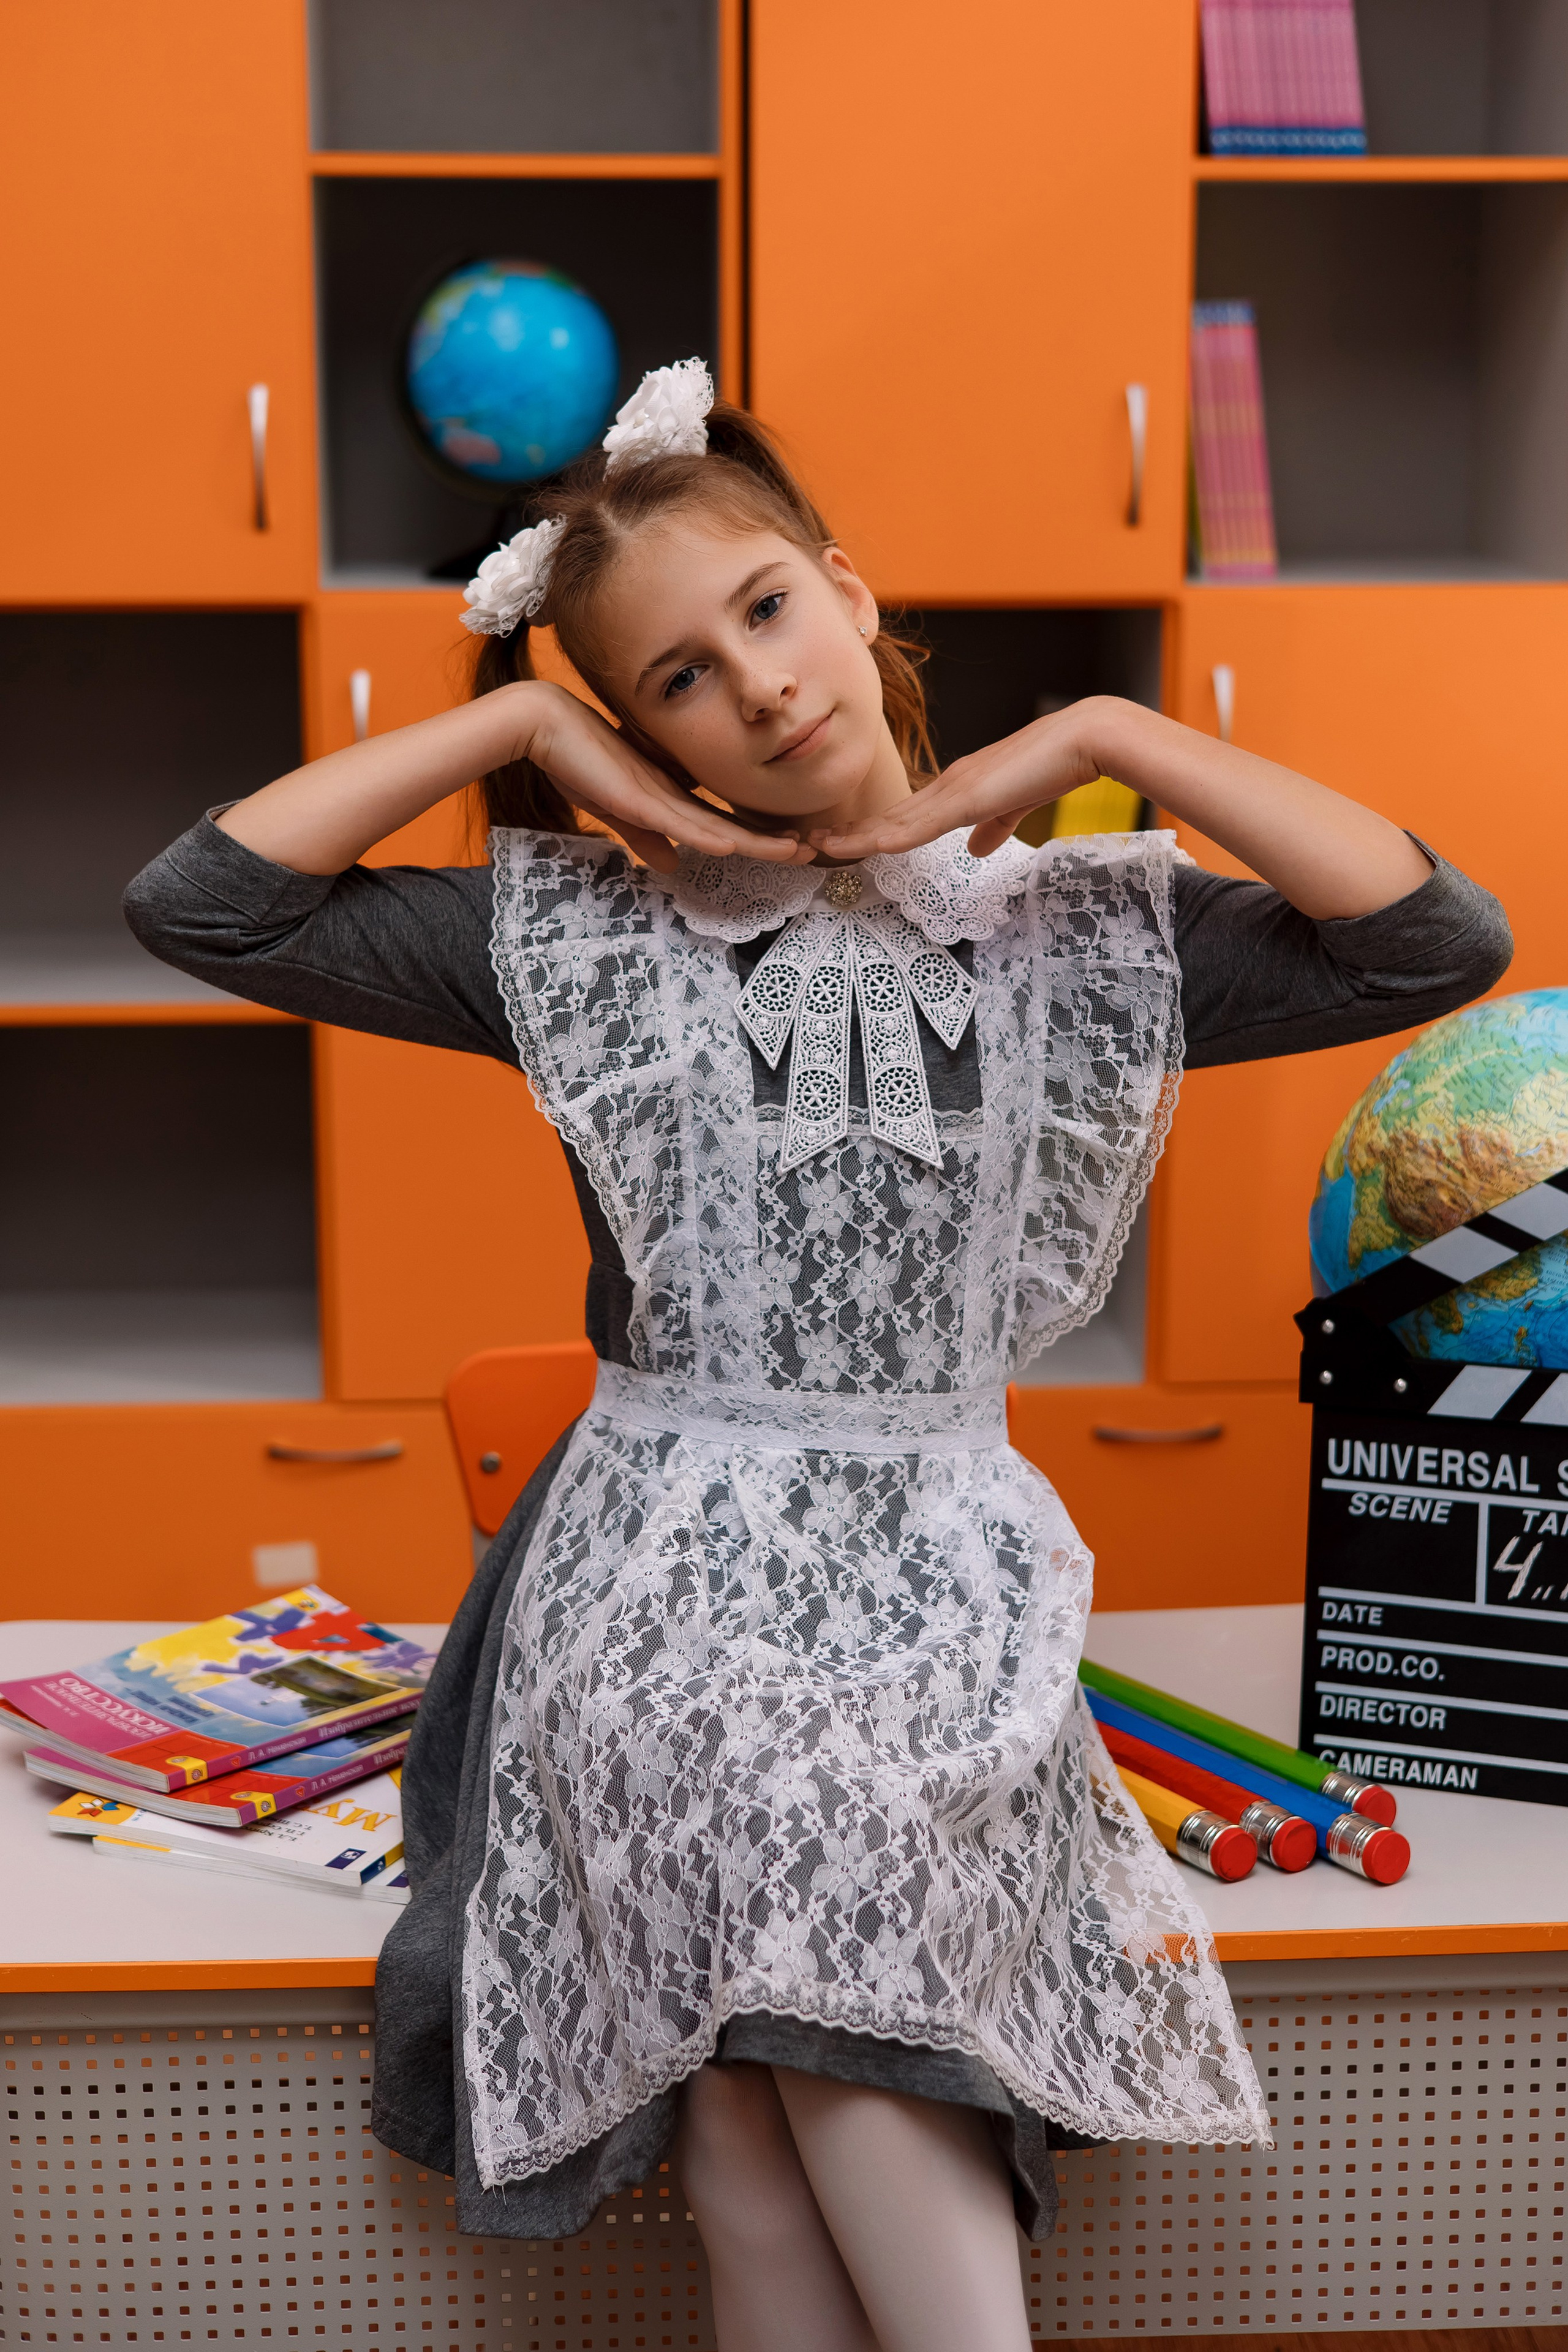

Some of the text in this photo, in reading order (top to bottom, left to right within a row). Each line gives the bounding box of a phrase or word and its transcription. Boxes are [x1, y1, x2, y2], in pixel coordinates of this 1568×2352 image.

[1328, 1438, 1540, 1493] UNIVERSAL
[1348, 1492, 1453, 1525] SCENE
[1322, 1600, 1384, 1626] DATE
[1321, 1645, 1446, 1681] PROD.CO.
[59, 1678, 172, 1735] ИСКУССТВО
[1319, 1694, 1447, 1731] DIRECTOR
